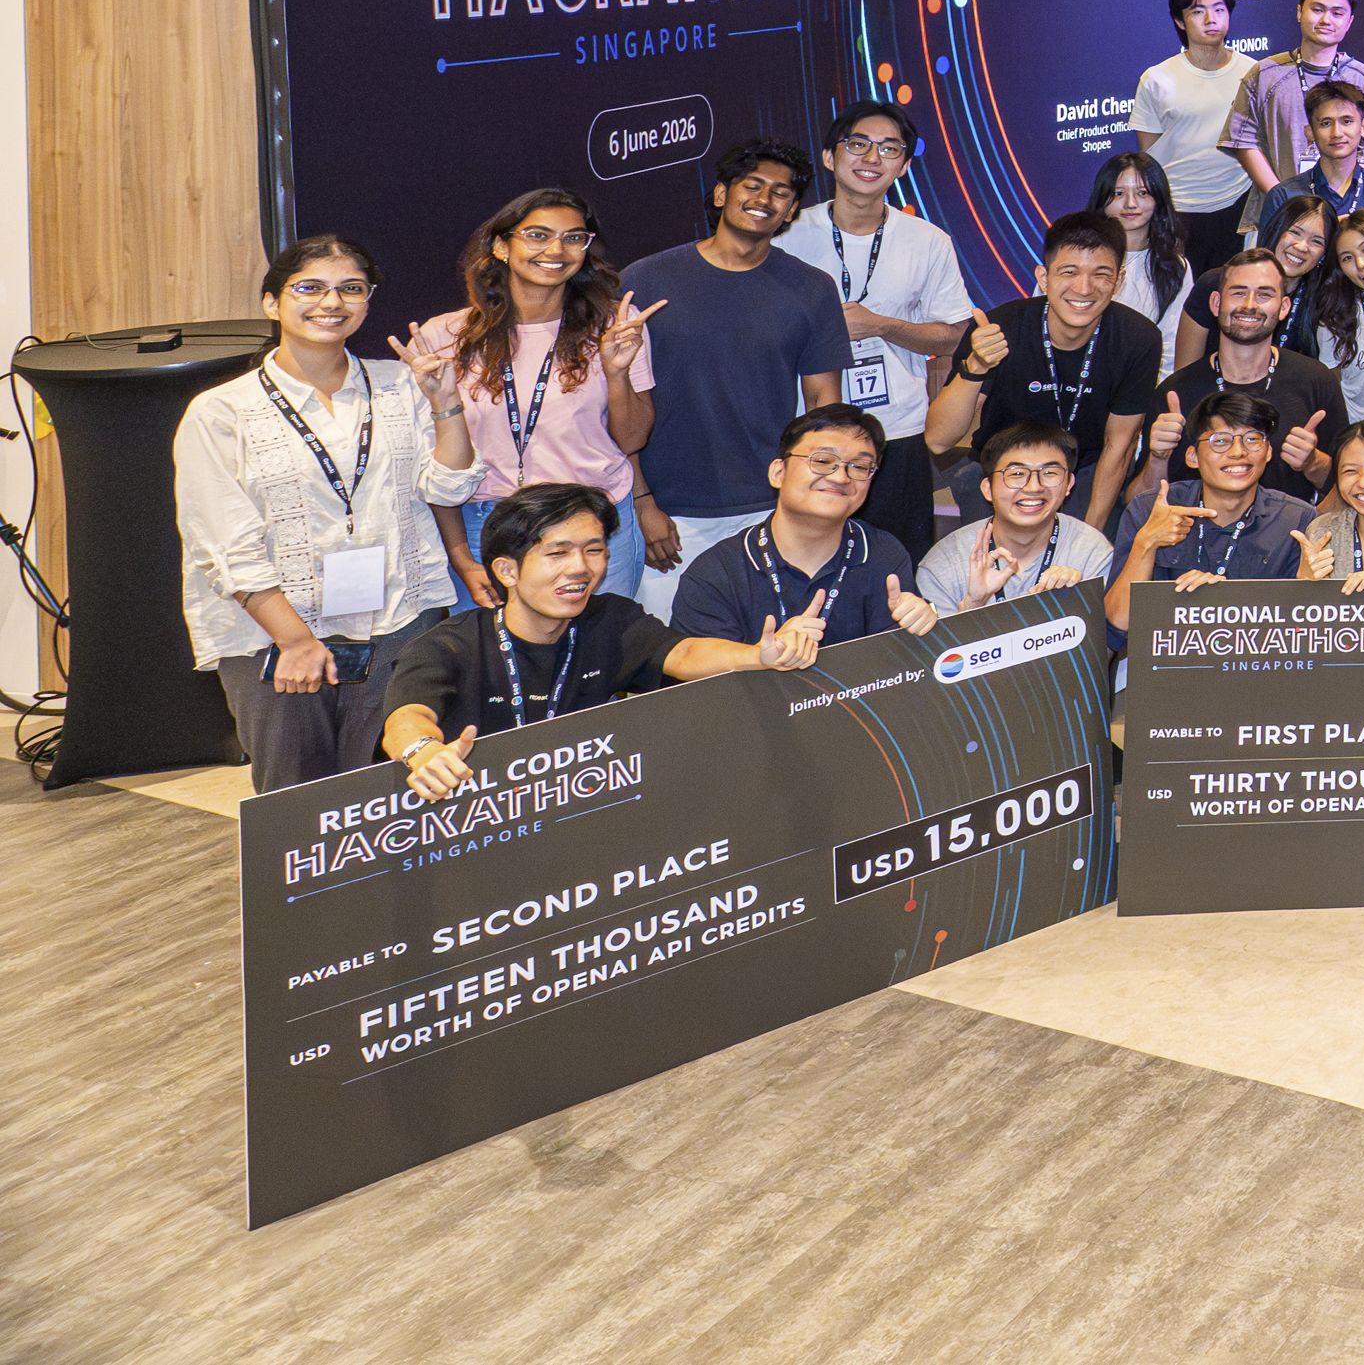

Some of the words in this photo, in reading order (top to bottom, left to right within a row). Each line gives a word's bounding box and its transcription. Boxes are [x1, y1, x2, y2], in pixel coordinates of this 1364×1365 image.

[575, 23, 717, 64] SINGAPORE
[1232, 37, 1268, 52] HONOR
[1056, 99, 1098, 122] David
[609, 134, 619, 156] 6
[621, 126, 658, 160] June
[662, 116, 697, 144] 2026
[1057, 128, 1078, 141] Chief
[1079, 124, 1109, 139] Product
[1110, 121, 1136, 134] Offic
[1082, 139, 1111, 153] Shopee
[854, 369, 877, 377] GROUP
[856, 376, 877, 394] 17
[1174, 606, 1286, 625] REGIONAL
[1292, 604, 1364, 623] CODEX
[970, 646, 1002, 667] sea
[1023, 626, 1076, 651] OpenAI
[1222, 659, 1314, 672] SINGAPORE
[788, 694, 834, 716] Jointly
[836, 673, 902, 700] organized
[905, 669, 925, 683] by:
[1150, 728, 1202, 739] PAYABLE
[1206, 727, 1223, 738] TO
[1238, 724, 1314, 746] FIRST
[507, 734, 615, 780] CODEX
[1147, 789, 1172, 800] USD
[1189, 772, 1291, 794] THIRTY
[285, 753, 642, 885] HACKATHON
[1190, 799, 1260, 817] WORTH
[1268, 799, 1294, 815] OF
[403, 820, 543, 872] SINGAPORE
[851, 847, 914, 885] USD
[924, 779, 1080, 862] 15,000
[288, 953, 375, 990] PAYABLE
[381, 942, 408, 959] TO
[432, 883, 598, 954] SECOND
[613, 839, 730, 897] PLACE
[290, 1043, 330, 1066] USD
[359, 957, 535, 1037] FIFTEEN
[551, 884, 758, 970] THOUSAND
[361, 1011, 472, 1063] WORTH
[483, 995, 522, 1020] OF
[532, 957, 638, 1003] OPENAI
[648, 935, 692, 964] API
[701, 898, 806, 945] CREDITS
